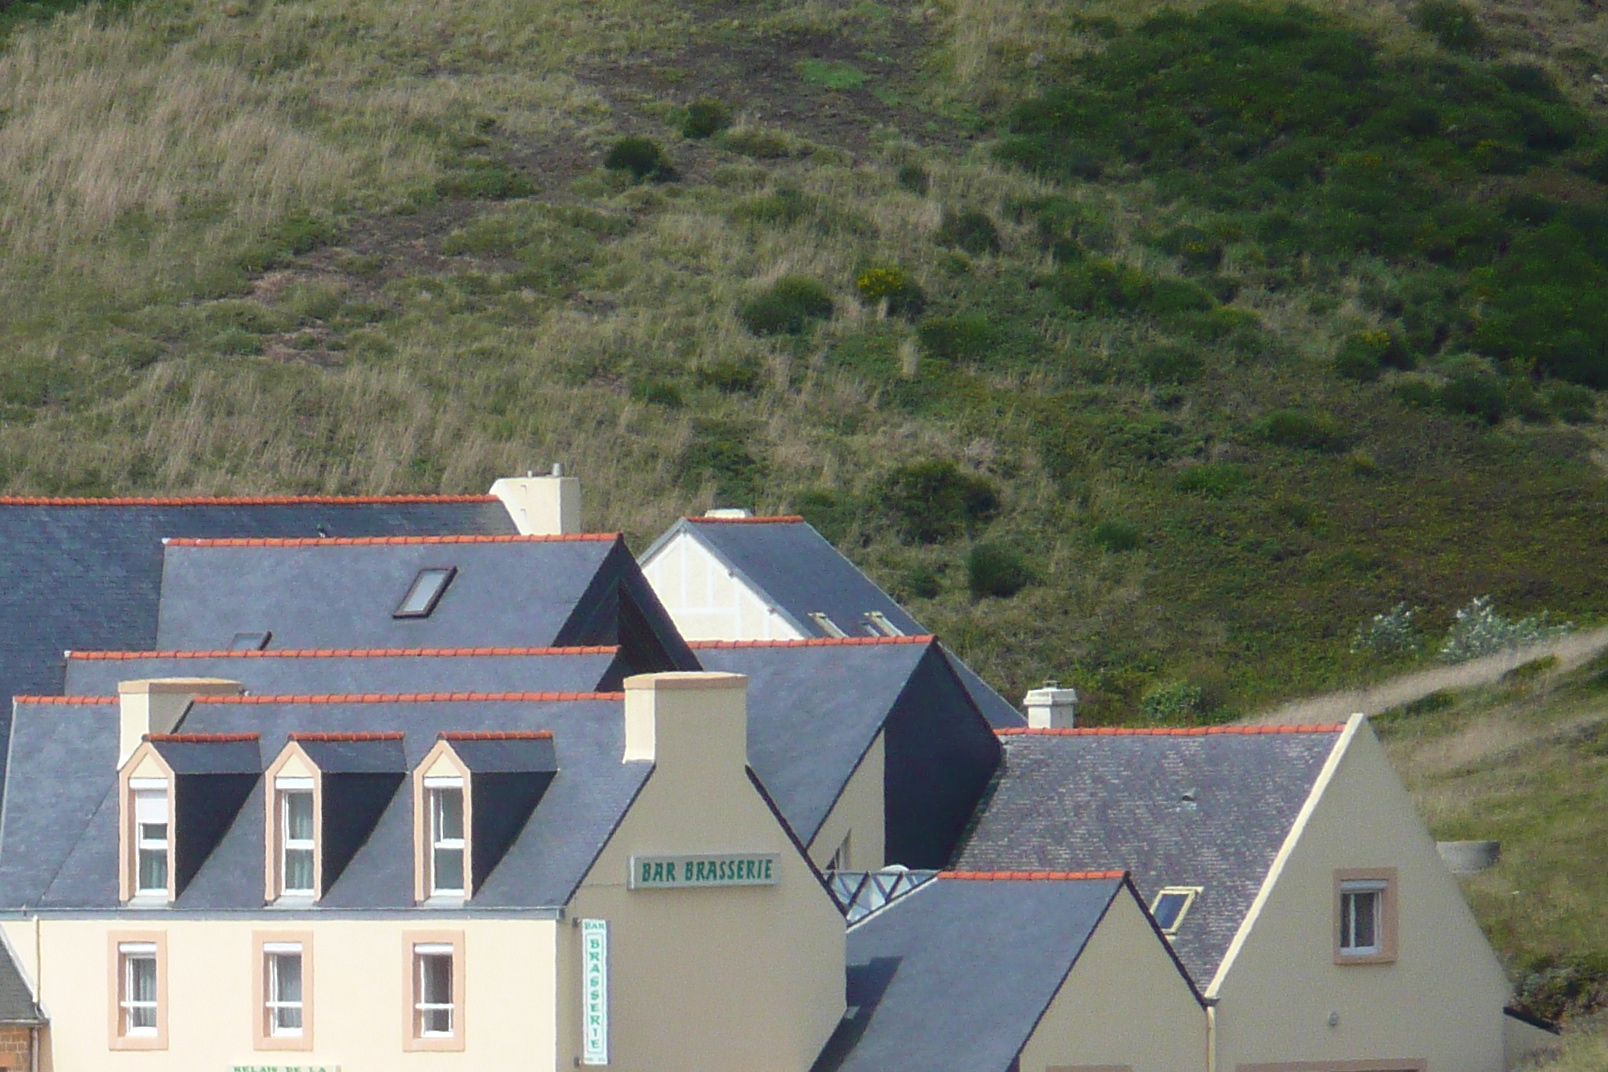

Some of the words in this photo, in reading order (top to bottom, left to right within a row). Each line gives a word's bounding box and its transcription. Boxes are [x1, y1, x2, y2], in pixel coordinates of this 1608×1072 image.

[642, 861, 676, 882] BAR
[684, 859, 773, 881] BRASSERIE
[584, 921, 605, 930] BAR
[589, 939, 600, 1049] BRASSERIE
